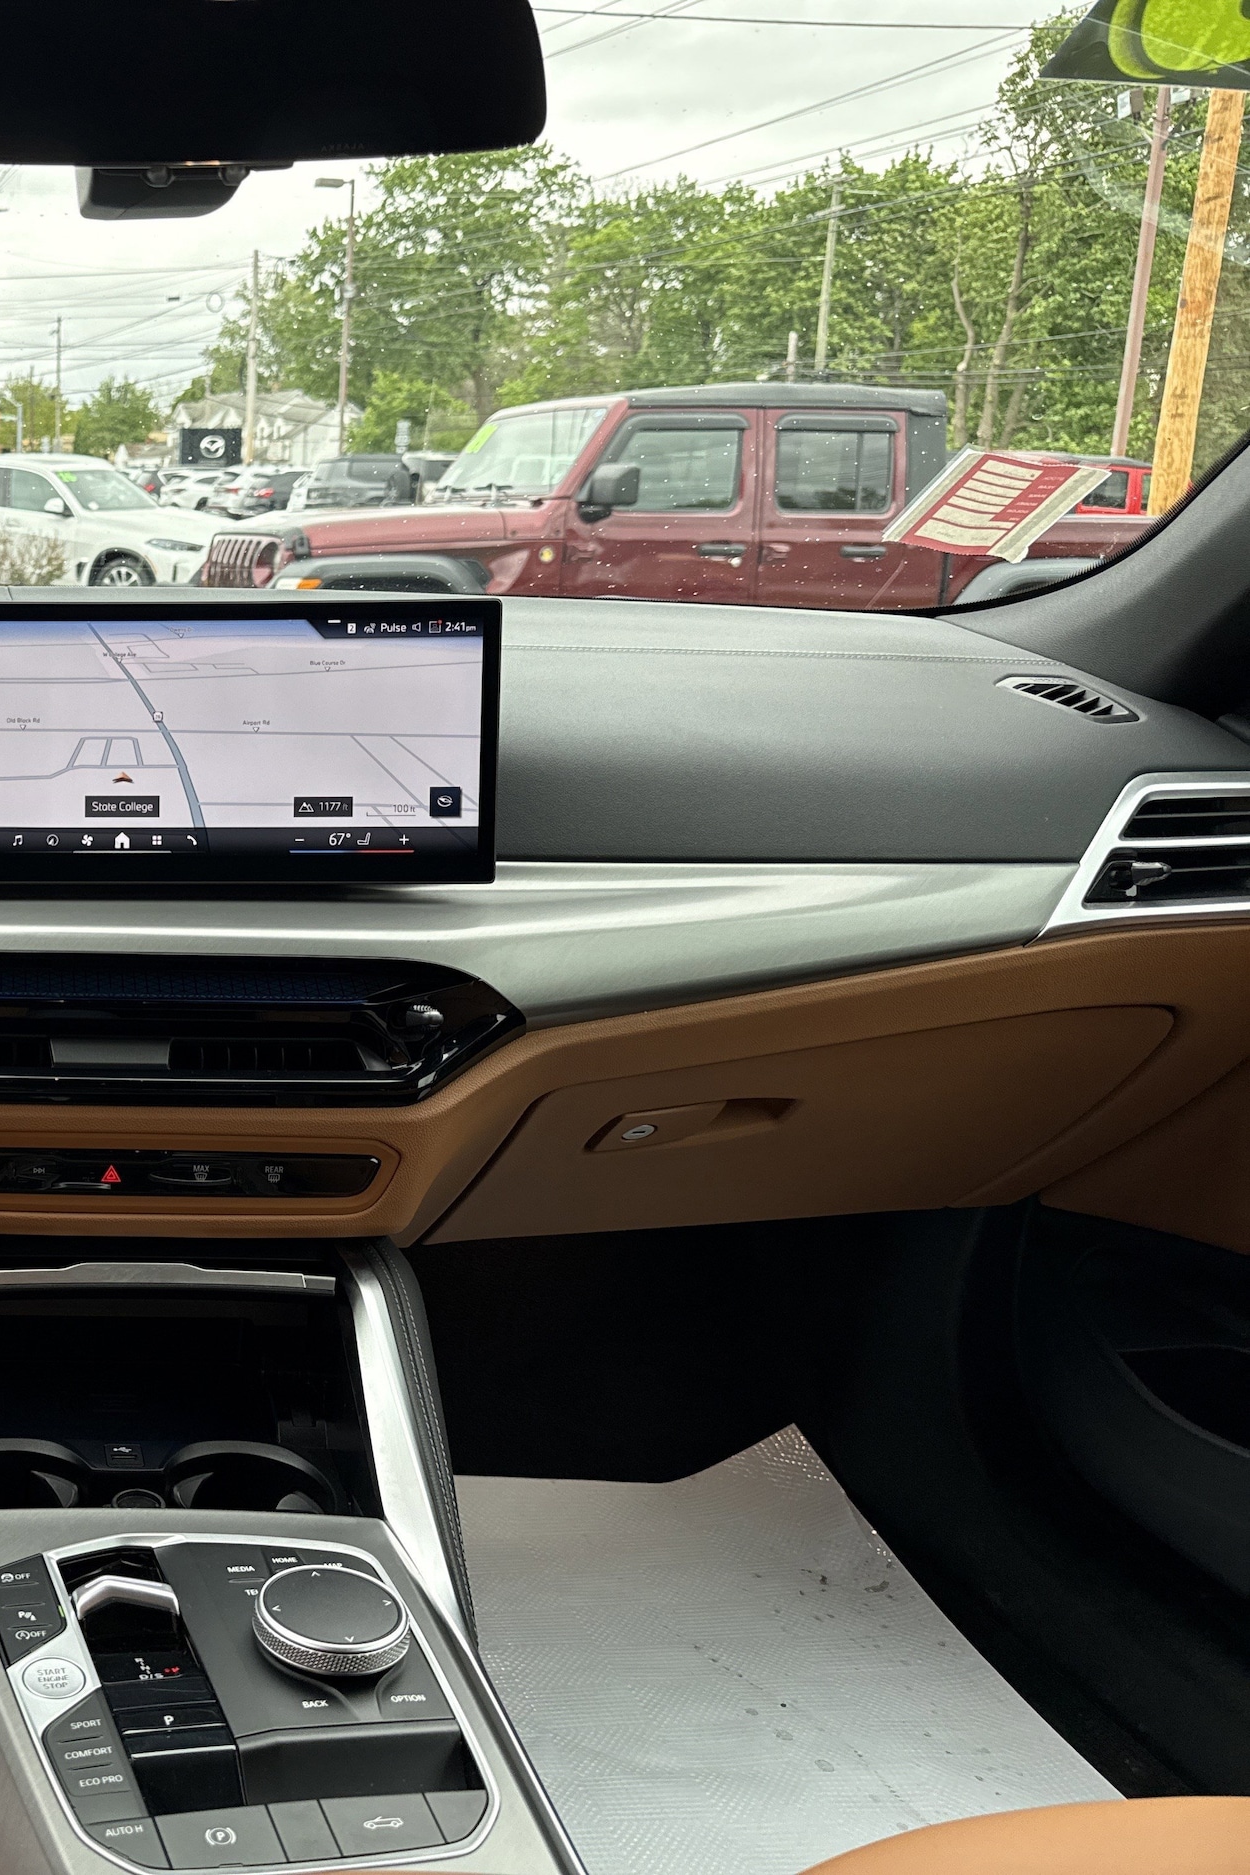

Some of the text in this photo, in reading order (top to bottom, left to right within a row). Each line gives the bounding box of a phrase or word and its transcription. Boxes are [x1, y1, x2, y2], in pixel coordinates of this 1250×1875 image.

[380, 623, 407, 633] Pulse
[91, 801, 154, 814] State College
[319, 801, 349, 811] 1177 ft
[392, 804, 409, 813] 100
[329, 832, 352, 846] 67°
[193, 1165, 210, 1173] MAX
[264, 1166, 284, 1174] REAR
[271, 1556, 299, 1564] HOME
[226, 1565, 256, 1574] MEDIA
[244, 1588, 259, 1596] TE
[36, 1667, 67, 1676] START
[37, 1674, 69, 1683] ENGINE
[42, 1682, 68, 1690] STOP
[390, 1694, 427, 1703] OPTION
[302, 1699, 329, 1708] BACK
[70, 1719, 102, 1730] SPORT
[163, 1715, 174, 1726] P
[64, 1746, 113, 1760] COMFORT
[79, 1774, 123, 1787] ECO PRO
[105, 1824, 144, 1837] AUTO H
